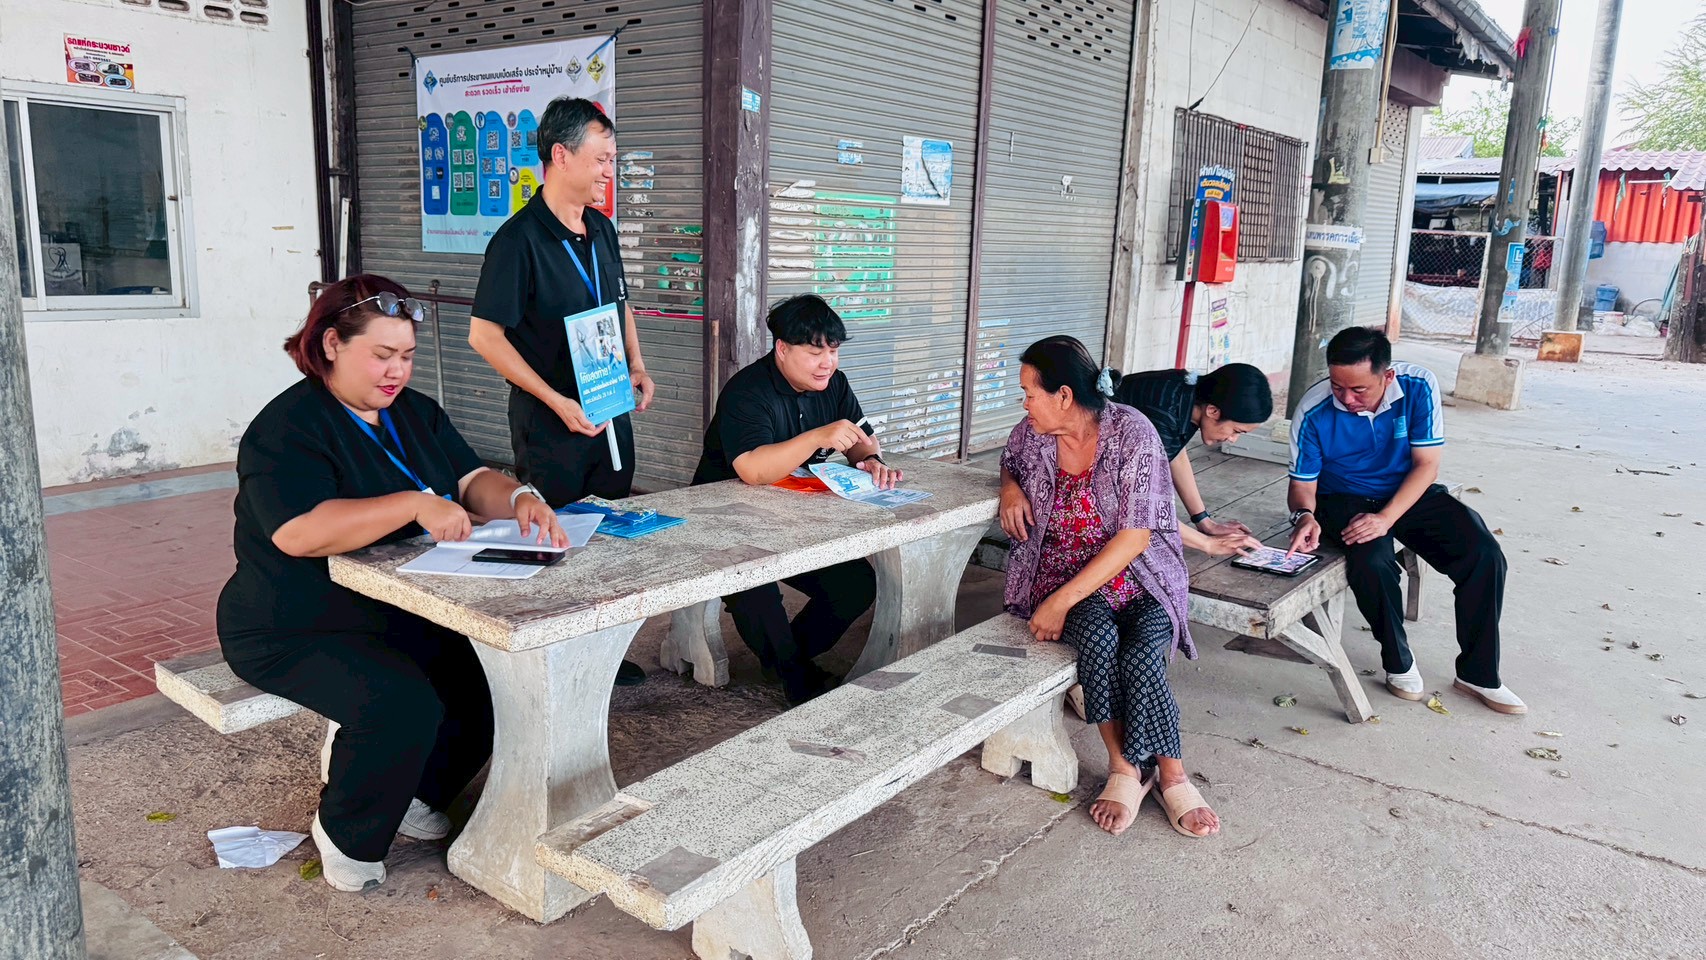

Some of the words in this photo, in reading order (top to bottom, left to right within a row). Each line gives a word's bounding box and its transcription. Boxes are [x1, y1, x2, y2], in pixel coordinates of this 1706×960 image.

[524, 64, 563, 78] ประจำหมู่บ้าน
[464, 89, 481, 97] สะดวก
[482, 86, 501, 96] รวดเร็ว
